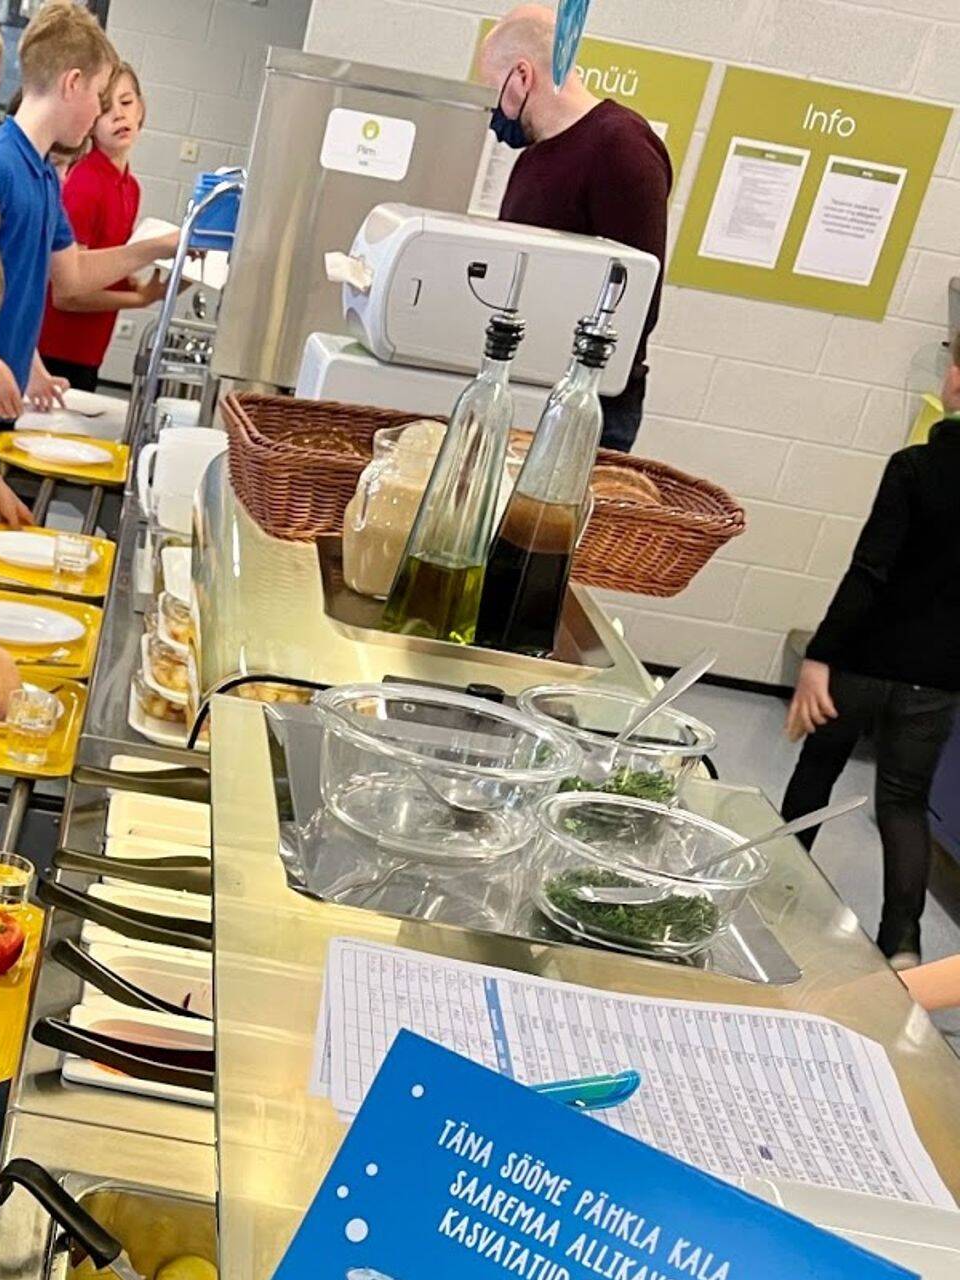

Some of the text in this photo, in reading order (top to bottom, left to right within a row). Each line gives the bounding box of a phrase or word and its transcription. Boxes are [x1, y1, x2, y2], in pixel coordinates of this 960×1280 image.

[802, 102, 856, 137] Info
[437, 1118, 495, 1169] TÄNA
[499, 1151, 572, 1207] SÖÖME
[572, 1189, 662, 1255] PÄHKLA
[449, 1169, 562, 1248] SAAREMAA
